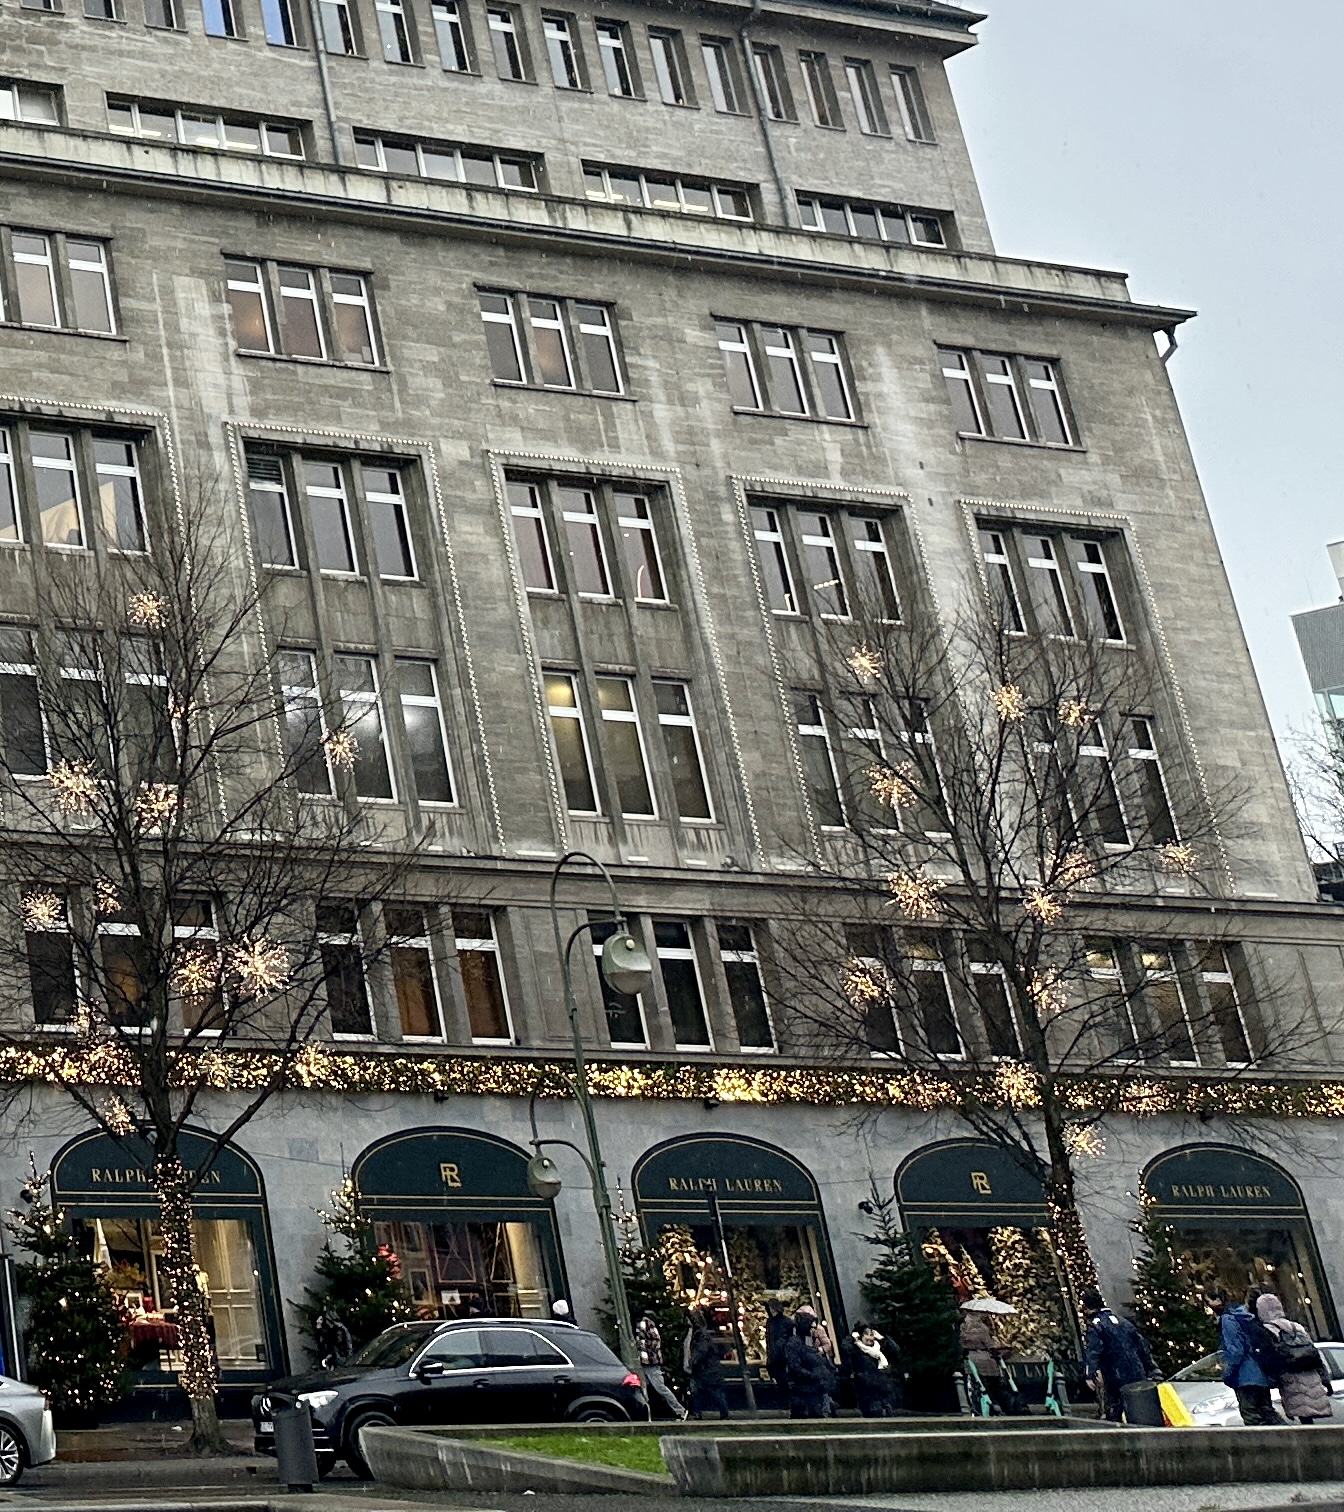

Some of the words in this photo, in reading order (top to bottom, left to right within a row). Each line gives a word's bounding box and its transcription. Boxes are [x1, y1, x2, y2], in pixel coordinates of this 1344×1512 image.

[91, 1167, 147, 1183] RALPH
[725, 1178, 782, 1192] LAUREN
[1171, 1184, 1215, 1198] RALPH
[1220, 1185, 1271, 1199] LAUREN
